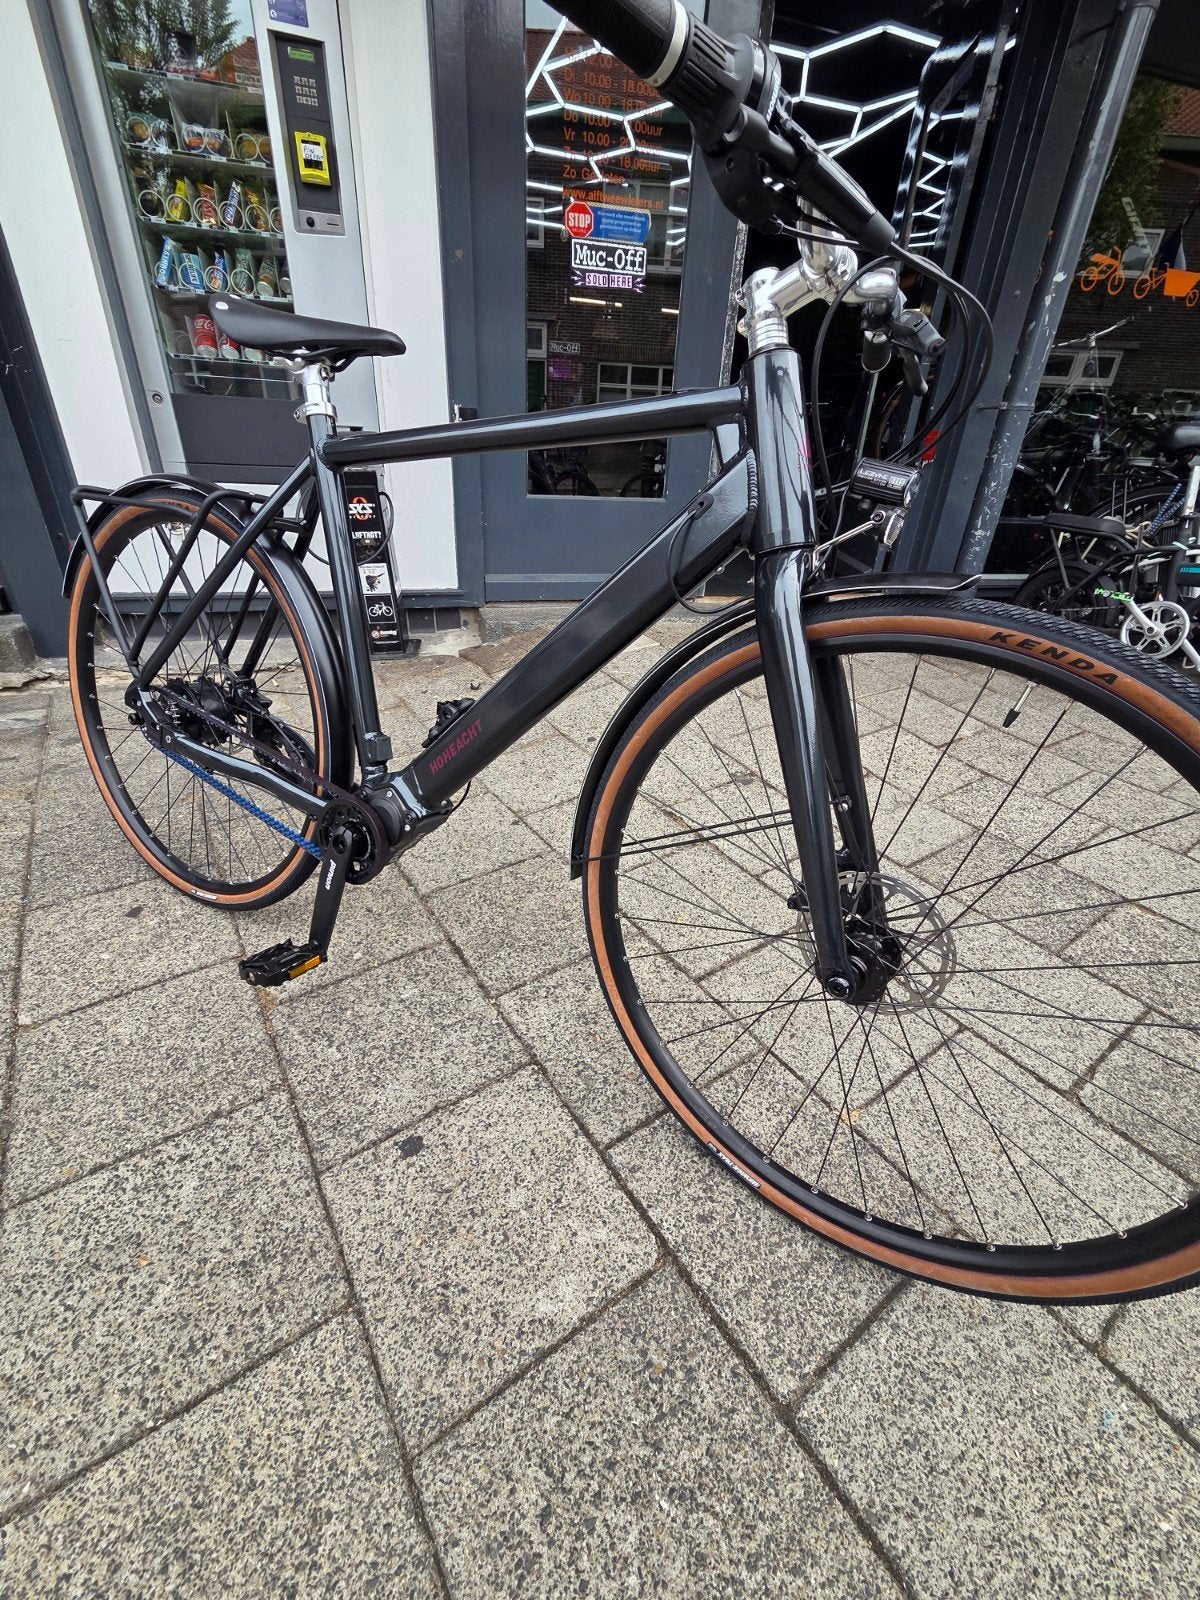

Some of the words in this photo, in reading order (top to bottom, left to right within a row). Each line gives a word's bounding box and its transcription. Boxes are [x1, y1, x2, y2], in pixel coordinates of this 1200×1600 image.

[563, 126, 576, 141] Vr
[582, 131, 610, 147] 10.00
[562, 164, 577, 178] Zo
[568, 213, 591, 228] STOP
[575, 244, 644, 272] Muc-Off
[586, 273, 608, 287] SOLD
[610, 275, 632, 288] HERE
[550, 342, 579, 353] Muc-Off
[348, 503, 373, 514] SKS
[987, 631, 1119, 685] KENDA
